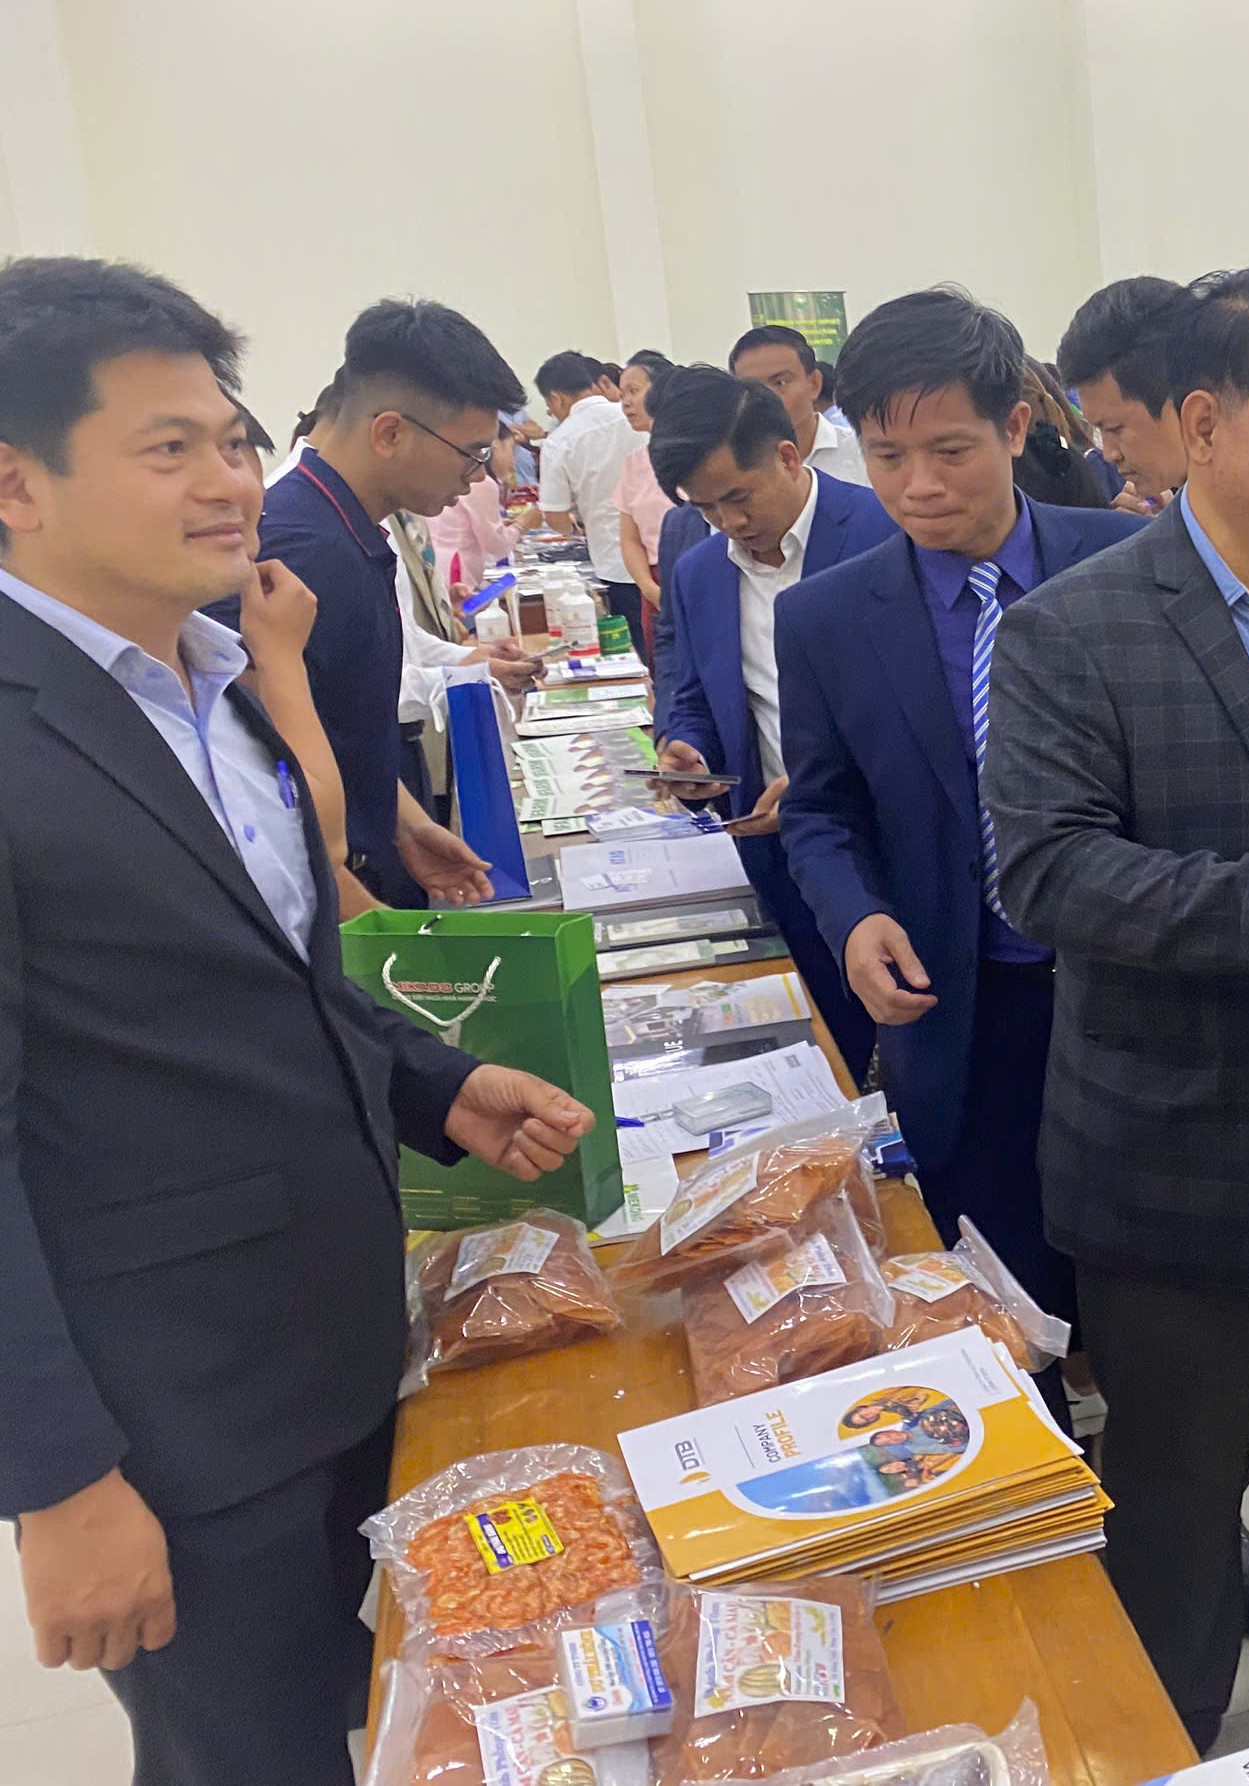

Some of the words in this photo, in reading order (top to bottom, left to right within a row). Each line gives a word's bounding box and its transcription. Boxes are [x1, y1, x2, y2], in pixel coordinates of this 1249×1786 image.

[454, 982, 495, 994] GROP
[753, 1424, 781, 1463] COMPANY
[766, 1410, 800, 1458] PROFILE
